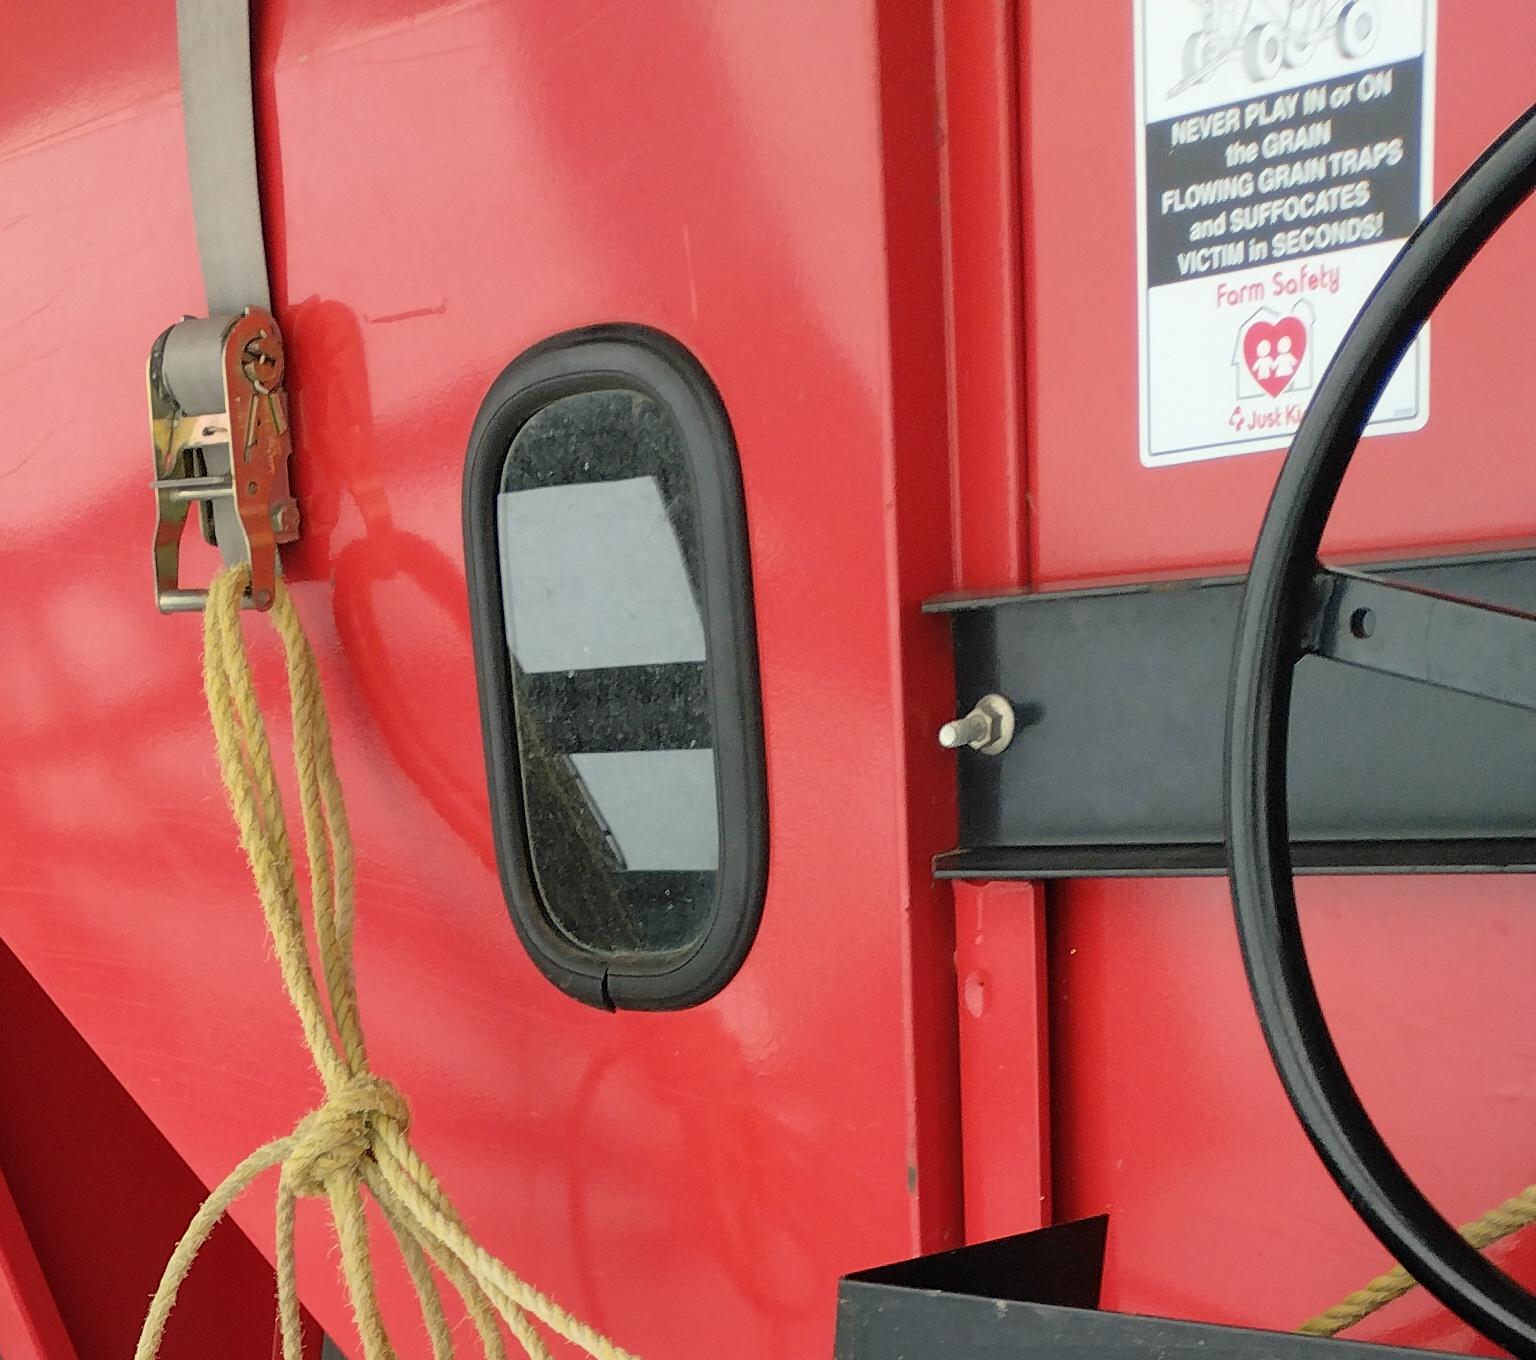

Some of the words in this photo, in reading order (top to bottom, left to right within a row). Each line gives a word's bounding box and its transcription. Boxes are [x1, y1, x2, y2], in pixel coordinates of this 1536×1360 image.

[1171, 107, 1241, 146] NEVER
[1244, 92, 1299, 130] PLAY
[1303, 86, 1328, 116] IN
[1330, 83, 1356, 109] or
[1357, 68, 1394, 103] ON
[1225, 139, 1259, 168] the
[1262, 119, 1332, 160] GRAIN
[1161, 171, 1254, 216] FLOWING
[1257, 155, 1328, 194] GRAIN
[1328, 137, 1404, 178] TRAPS
[1189, 210, 1227, 242] and
[1229, 179, 1371, 234] SUFFOCATES
[1177, 240, 1245, 276] VICTIM
[1248, 237, 1268, 263] in
[1271, 212, 1384, 258] SECONDS!
[1216, 281, 1265, 309] Farm
[1272, 263, 1341, 297] Safety
[1247, 405, 1282, 432] Just
[1285, 402, 1307, 426] Ki
